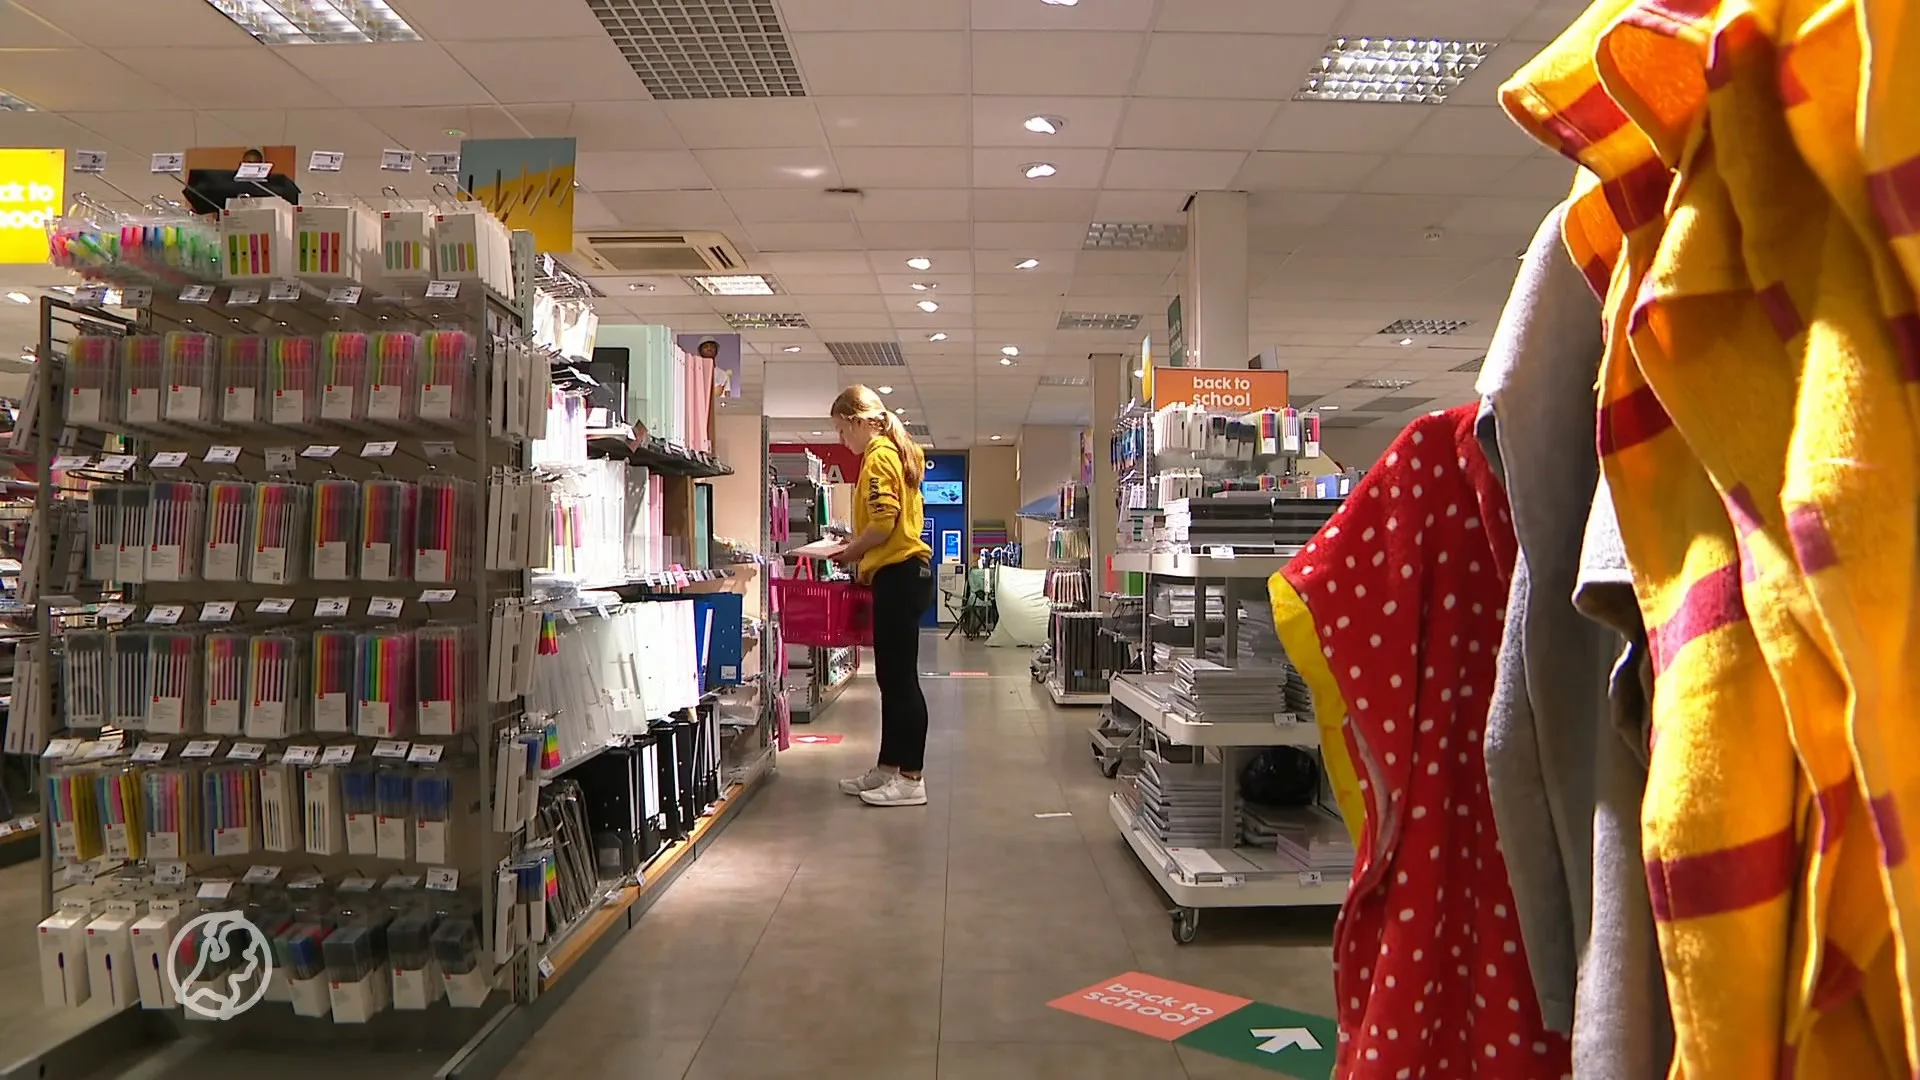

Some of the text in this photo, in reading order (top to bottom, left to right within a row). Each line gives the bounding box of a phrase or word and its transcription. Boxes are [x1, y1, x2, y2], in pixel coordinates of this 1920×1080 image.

[29, 181, 55, 202] to
[1193, 376, 1250, 390] back to
[1193, 391, 1250, 406] school
[1082, 991, 1201, 1026] school
[1104, 983, 1214, 1016] back to
